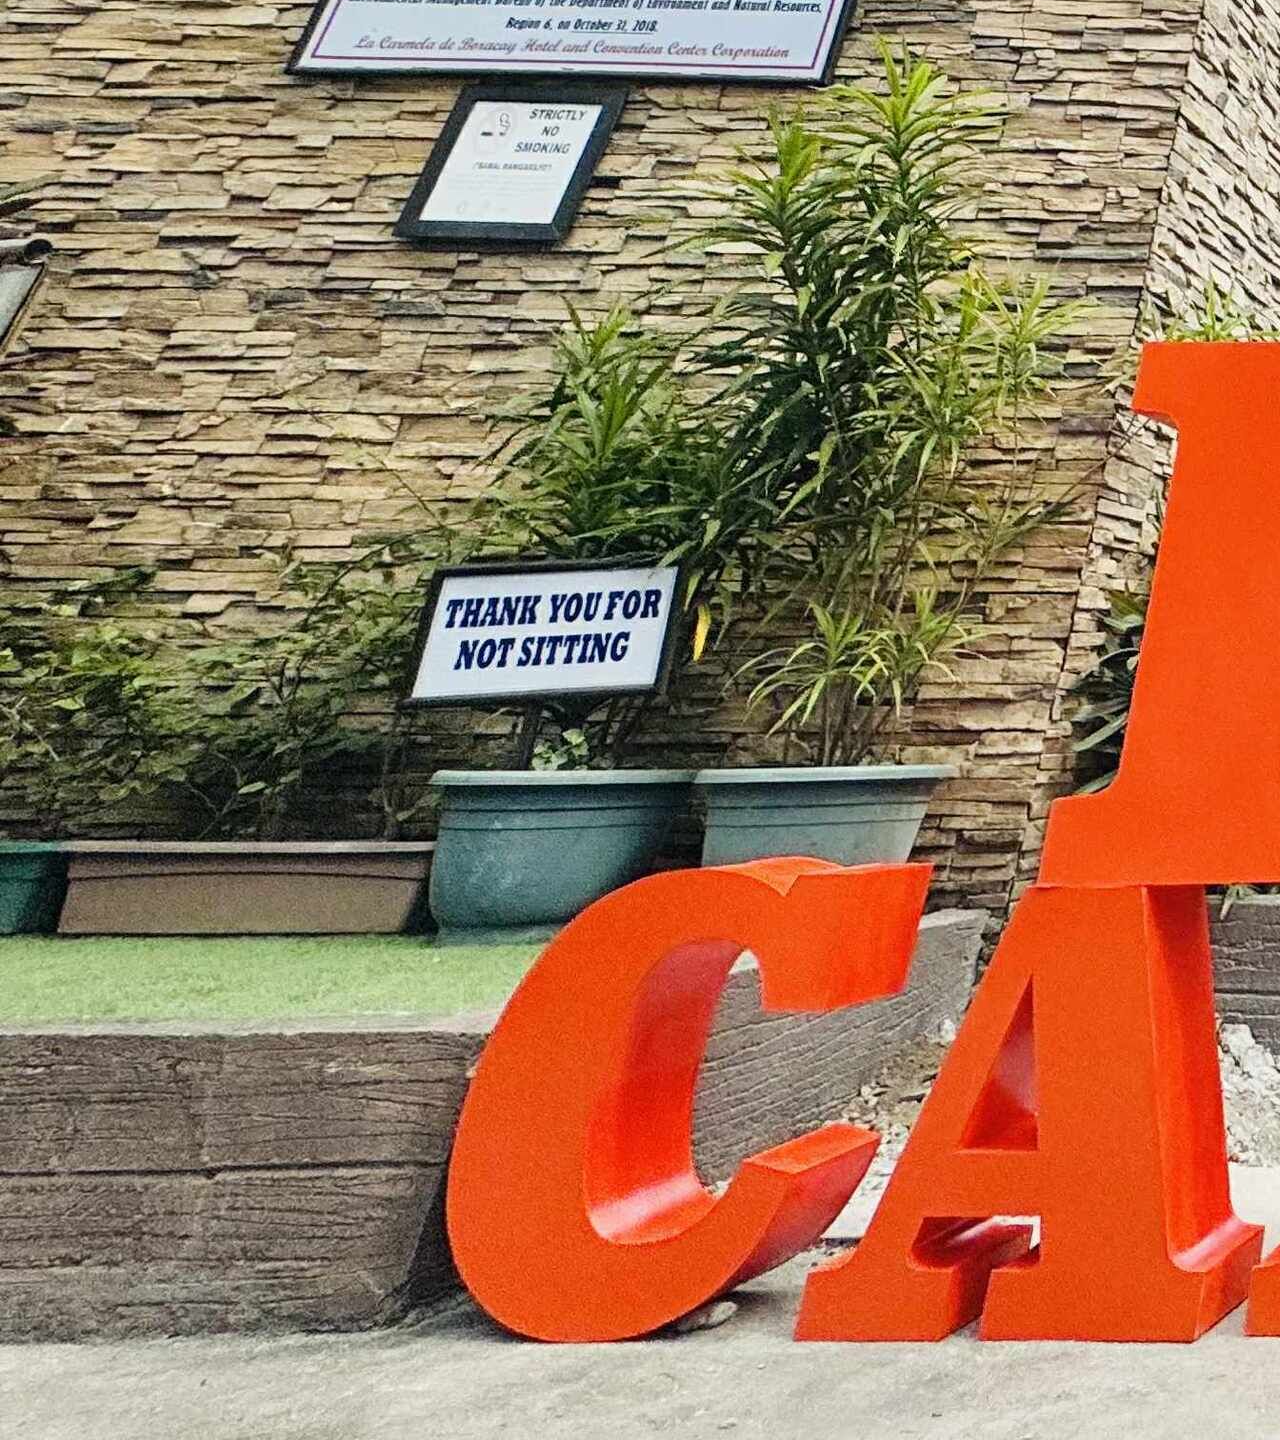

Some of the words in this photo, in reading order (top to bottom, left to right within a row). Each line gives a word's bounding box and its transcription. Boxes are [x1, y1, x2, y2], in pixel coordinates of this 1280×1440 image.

[711, 0, 731, 11] and
[733, 0, 772, 12] Natural
[505, 17, 541, 30] Region
[557, 20, 571, 30] on
[573, 19, 613, 31] October
[353, 35, 375, 49] La
[379, 36, 435, 50] Carmela
[438, 37, 456, 50] de
[457, 37, 517, 54] Boracay
[521, 39, 562, 52] Hotel
[561, 40, 591, 53] and
[592, 40, 663, 55] Convention
[667, 41, 707, 56] Center
[711, 42, 790, 60] Corporation
[529, 108, 588, 120] STRICTLY
[541, 125, 560, 137] NO
[514, 141, 571, 154] SMOKING
[445, 594, 542, 629] THANK
[549, 591, 603, 623] YOU
[603, 588, 662, 620] FOR
[454, 638, 515, 670] NOT
[516, 631, 631, 667] SITTING
